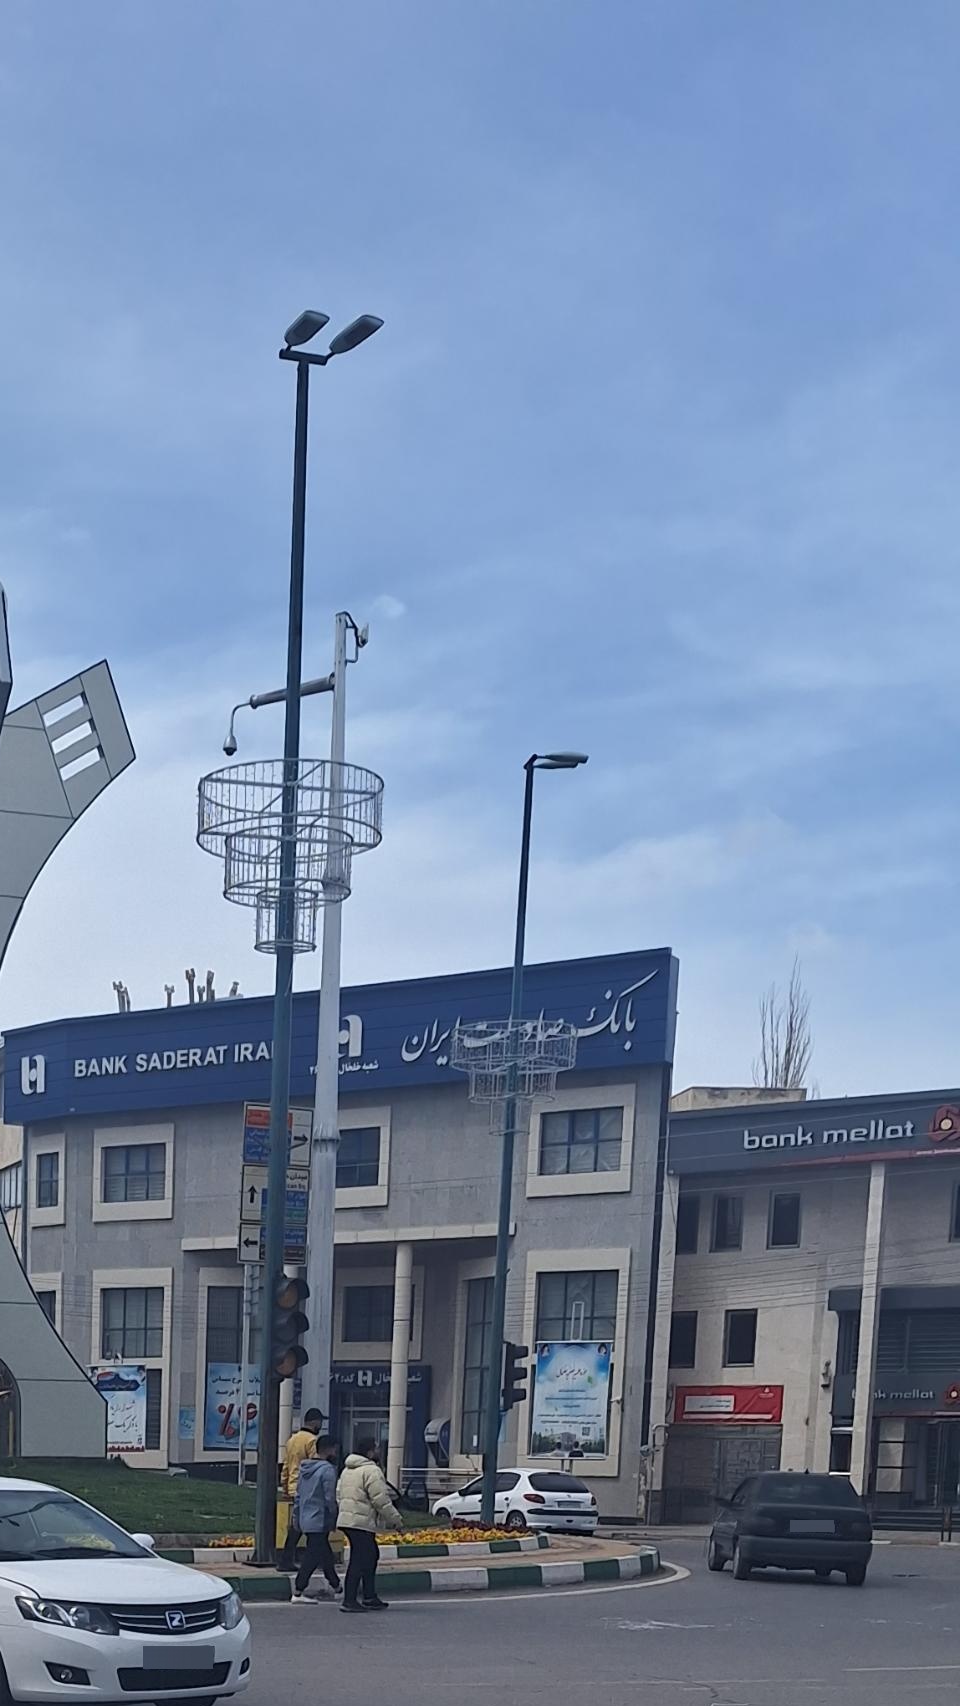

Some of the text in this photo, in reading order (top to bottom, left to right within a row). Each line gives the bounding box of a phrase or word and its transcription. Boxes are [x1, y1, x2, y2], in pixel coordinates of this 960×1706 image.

[575, 968, 659, 1051] بانک
[401, 1016, 462, 1065] ایران
[74, 1055, 128, 1078] BANK
[135, 1045, 228, 1072] SADERAT
[362, 1060, 379, 1074] شعبه
[743, 1119, 915, 1149] bank mellat
[407, 1371, 422, 1384] شعب
[851, 1388, 935, 1400] bnk mellat
